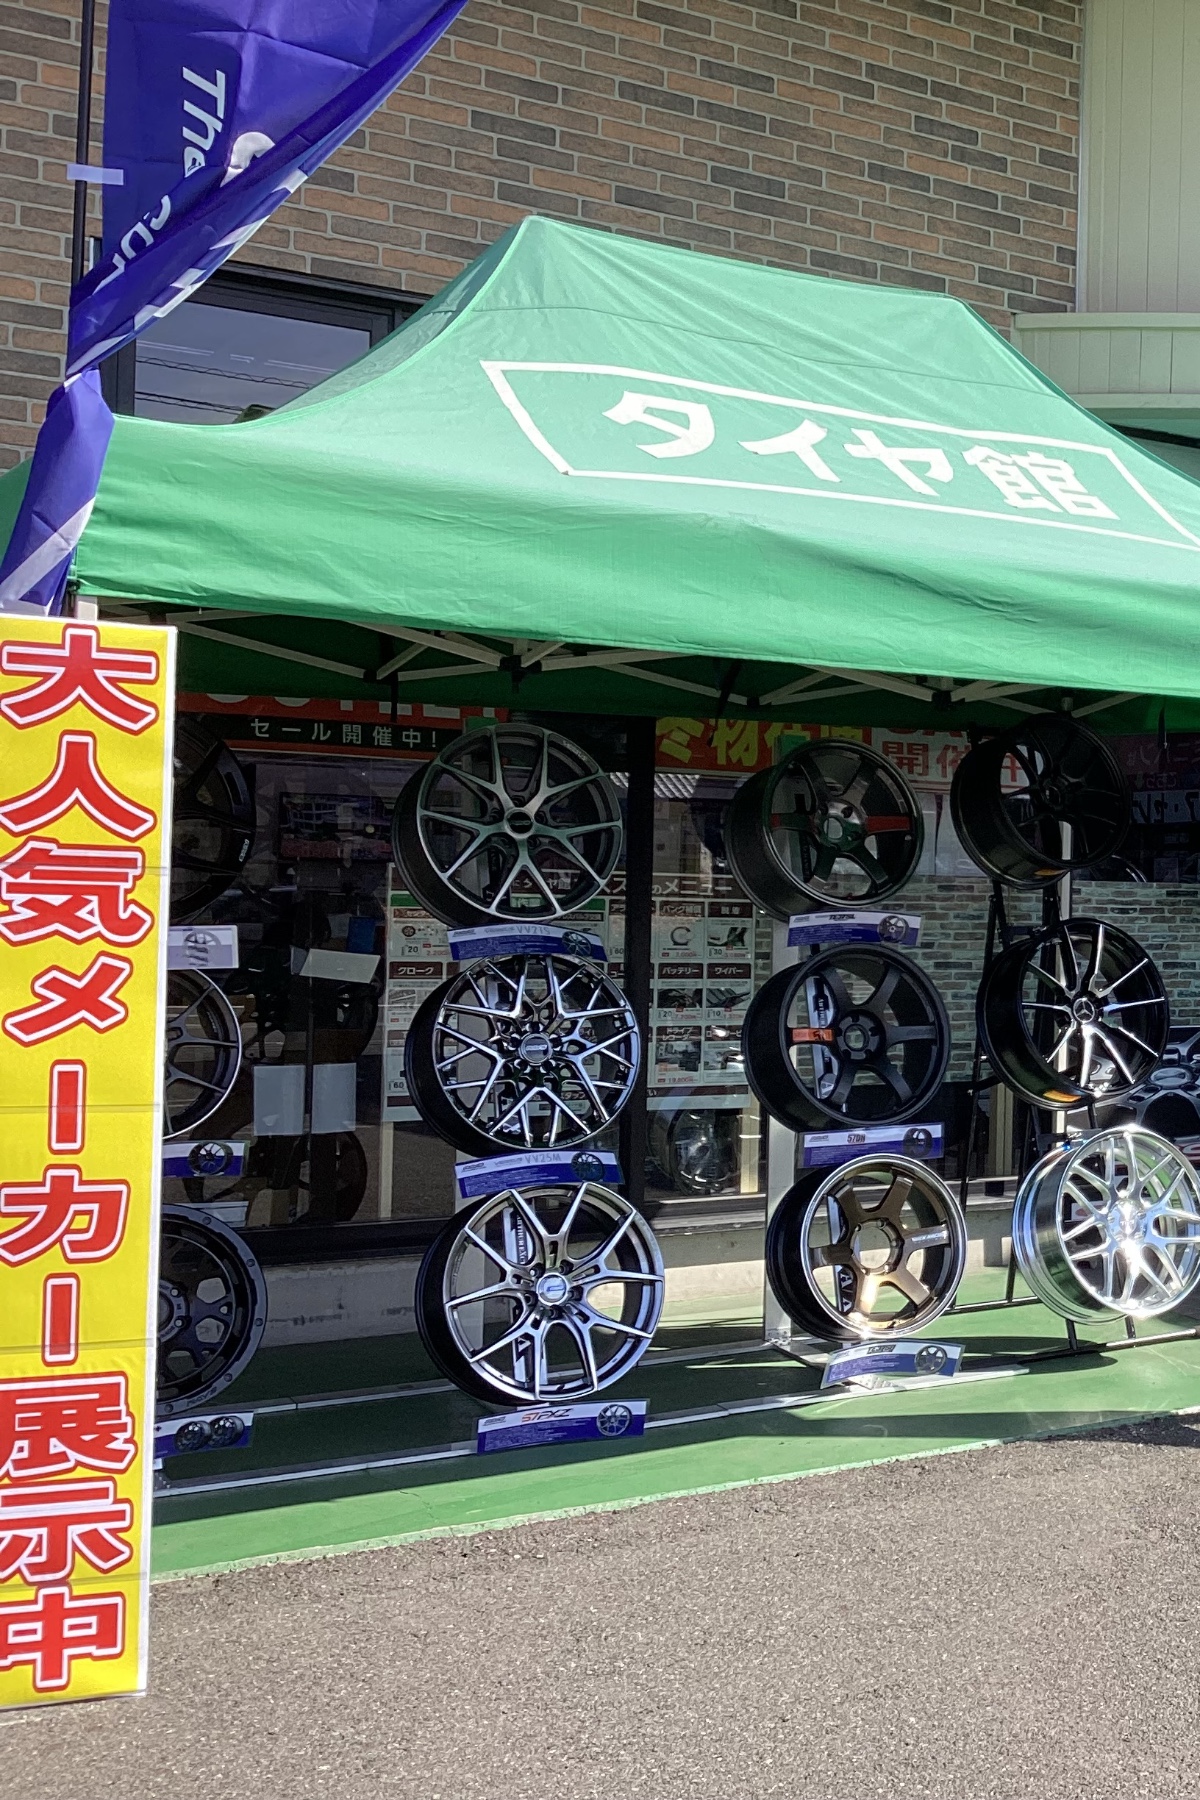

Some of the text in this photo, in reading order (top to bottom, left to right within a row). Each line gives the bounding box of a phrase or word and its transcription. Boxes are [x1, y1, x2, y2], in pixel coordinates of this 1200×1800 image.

[602, 389, 1120, 519] タイヤ館
[662, 966, 699, 975] バッテリー
[714, 966, 744, 975] ワイパー
[0, 625, 158, 1692] 大人気メーカー展示中
